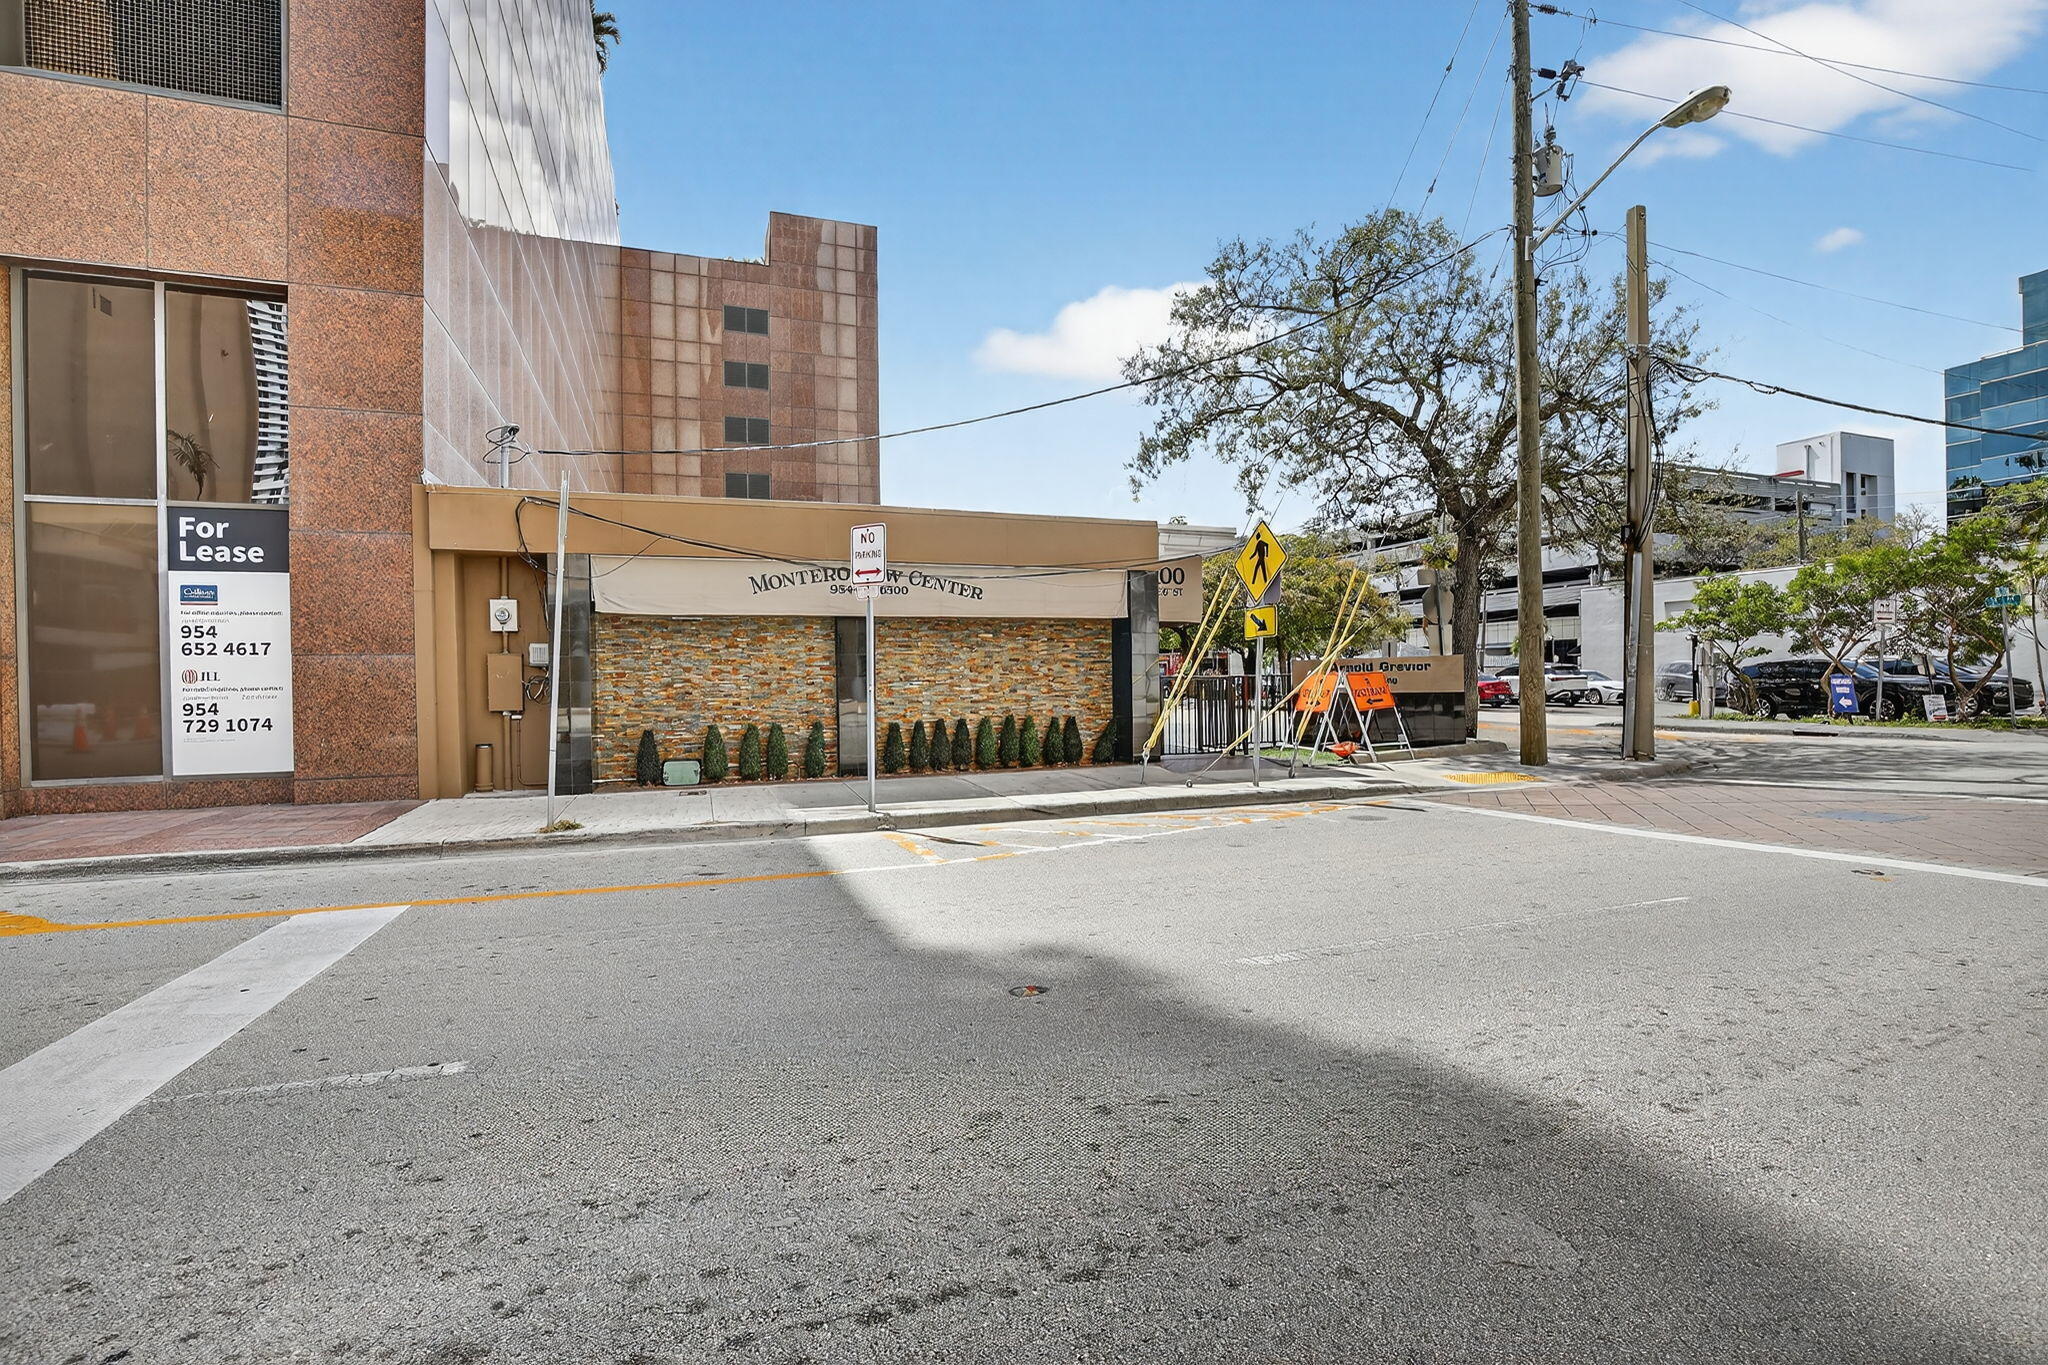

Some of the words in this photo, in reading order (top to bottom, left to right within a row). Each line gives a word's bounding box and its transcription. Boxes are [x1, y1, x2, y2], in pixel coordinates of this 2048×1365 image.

[179, 516, 230, 539] For
[860, 531, 875, 544] NO
[179, 540, 265, 563] Lease
[908, 570, 984, 600] CENTER
[180, 625, 218, 639] 954
[181, 642, 218, 656] 652
[223, 642, 271, 656] 4617
[182, 702, 219, 717] 954
[182, 719, 219, 733] 729
[226, 717, 273, 732] 1074
